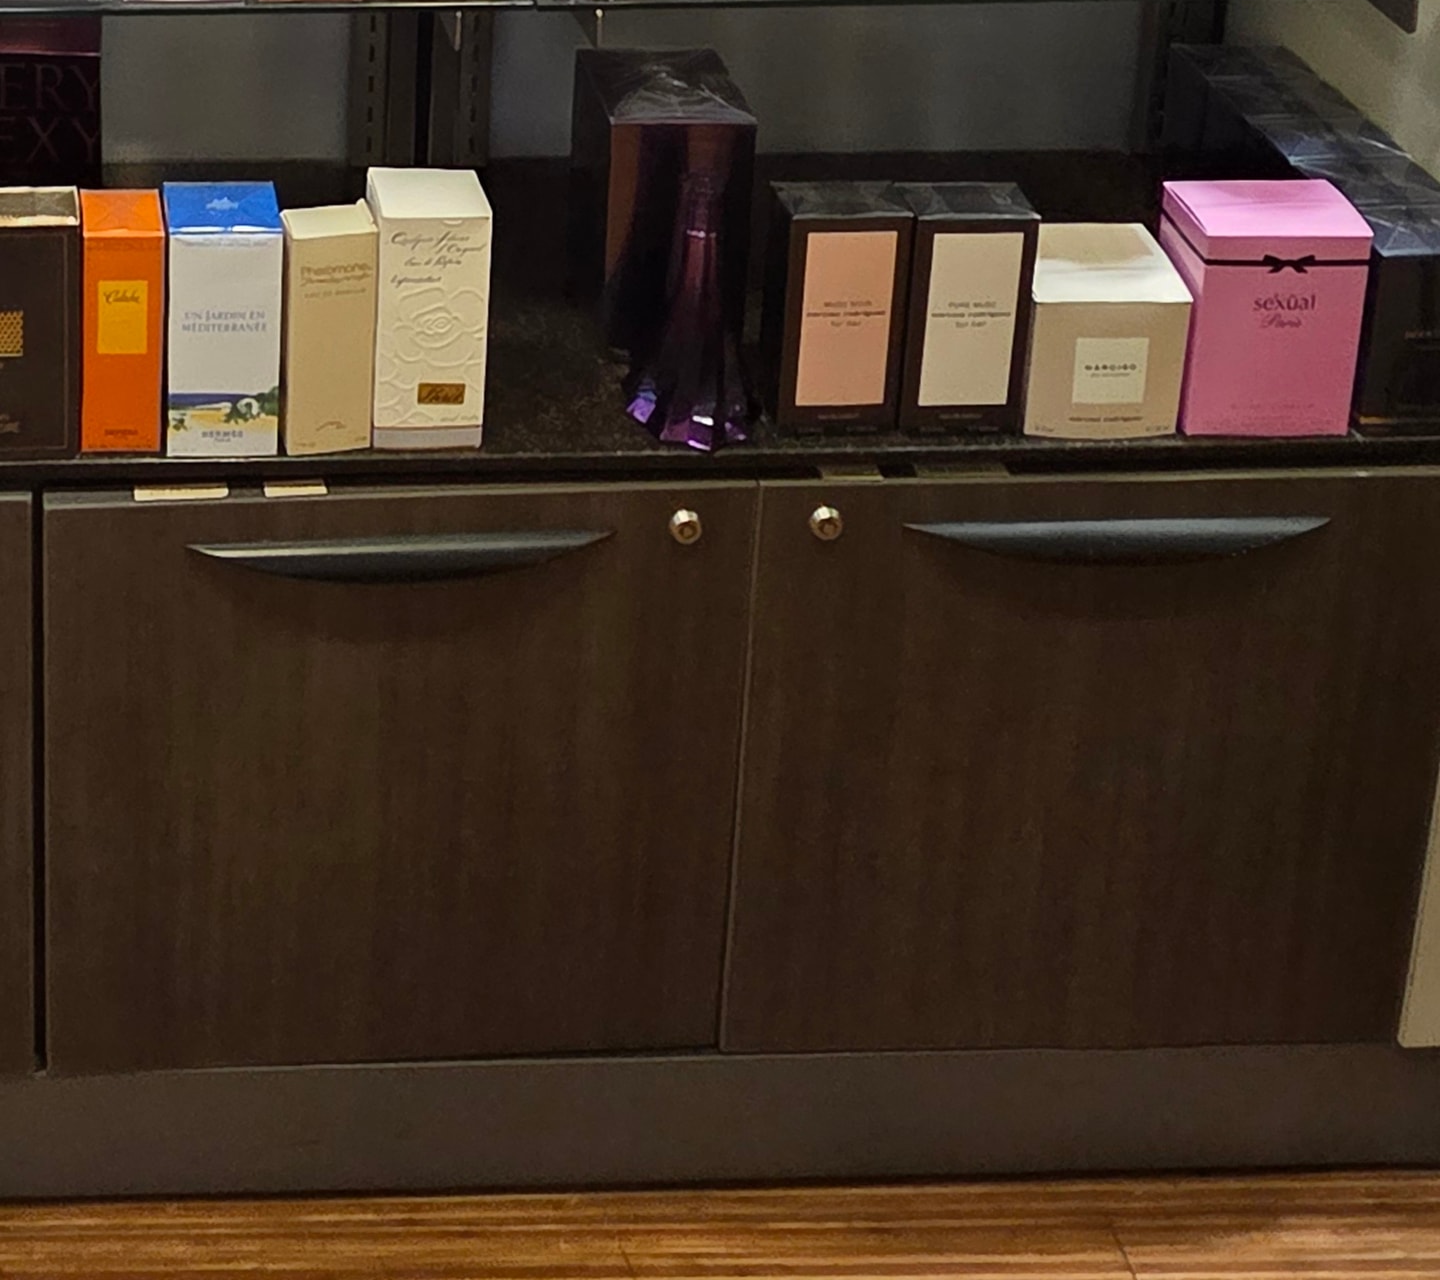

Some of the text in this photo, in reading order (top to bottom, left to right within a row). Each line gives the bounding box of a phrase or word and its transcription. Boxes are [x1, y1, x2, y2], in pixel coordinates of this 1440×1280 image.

[184, 310, 266, 322] UN JARDIN EN
[181, 321, 268, 333] MÉDITERRANÉE
